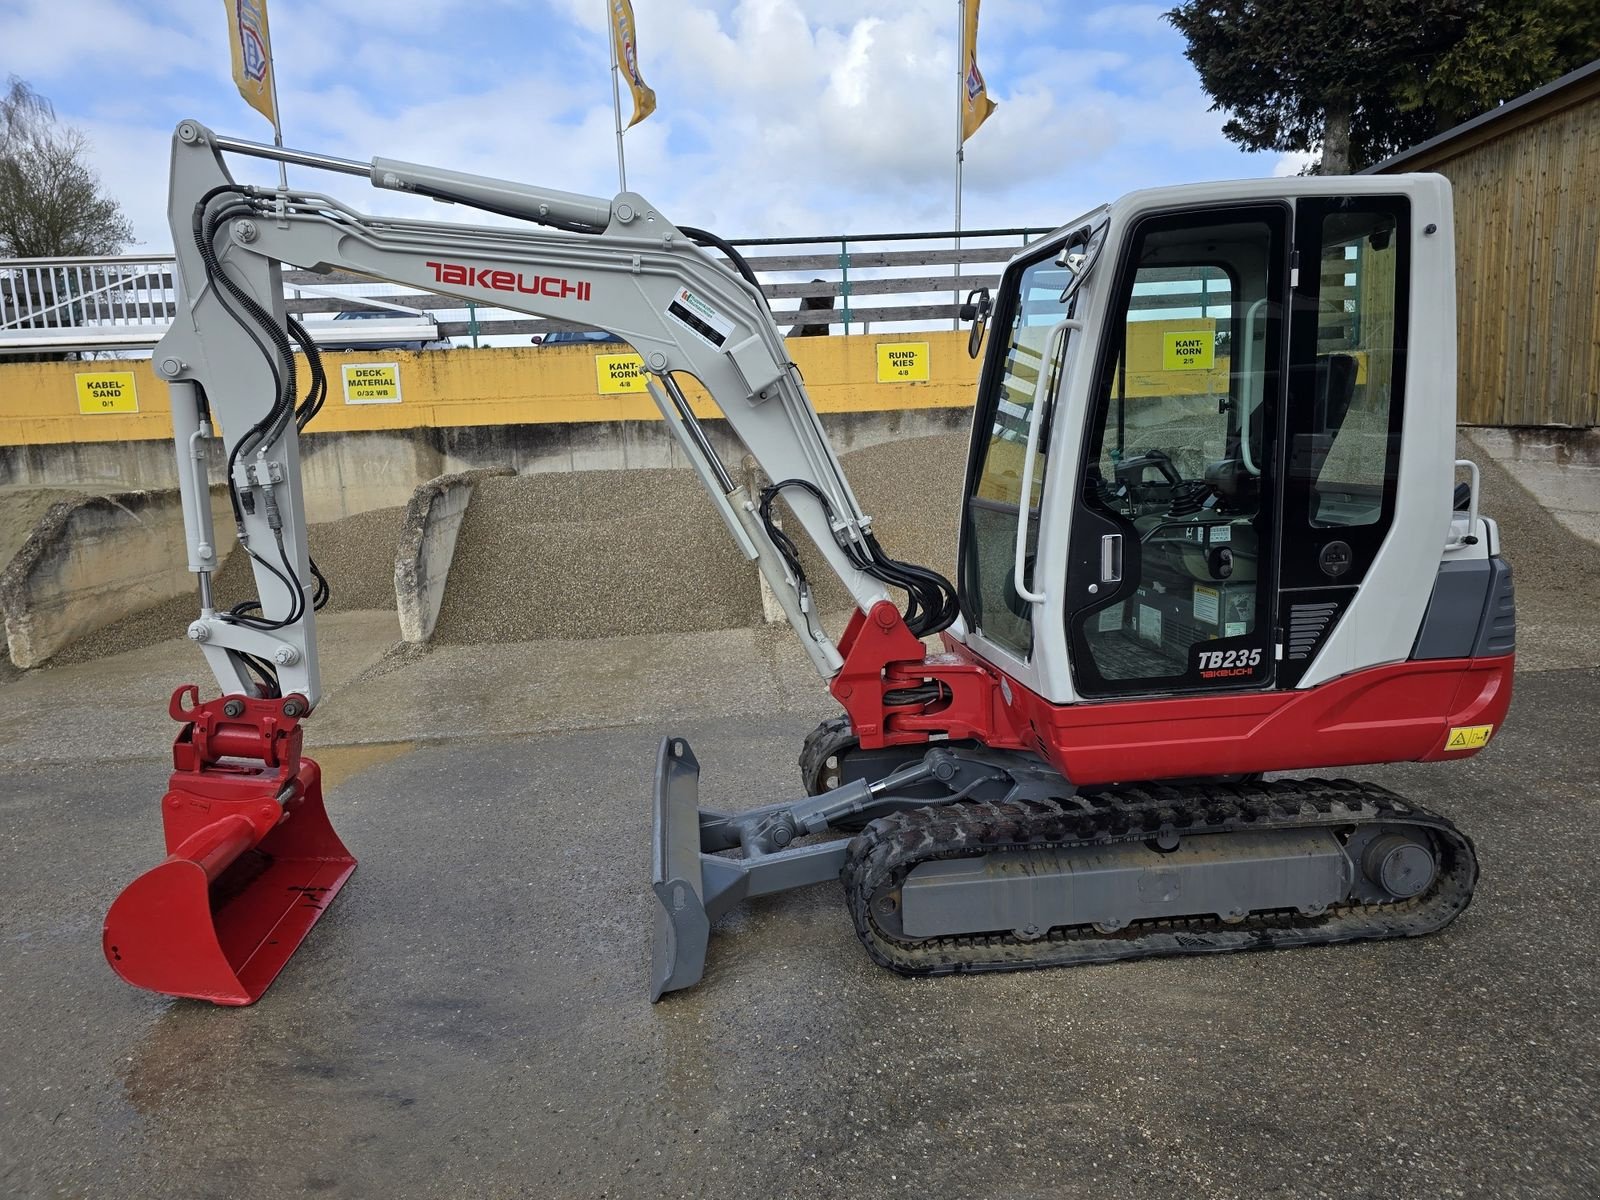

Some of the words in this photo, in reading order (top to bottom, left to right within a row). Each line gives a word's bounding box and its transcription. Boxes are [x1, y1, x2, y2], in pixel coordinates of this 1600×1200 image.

[1175, 339, 1204, 348] KANT-
[888, 351, 918, 360] RUND-
[1176, 347, 1202, 356] KORN
[609, 362, 639, 371] KANT-
[892, 359, 914, 367] KIES
[355, 369, 386, 378] DECK-
[610, 370, 638, 379] KORN
[87, 381, 126, 390] KABEL-
[348, 378, 396, 387] MATERIAL
[92, 389, 121, 398] SAND
[1198, 648, 1262, 670] TB235
